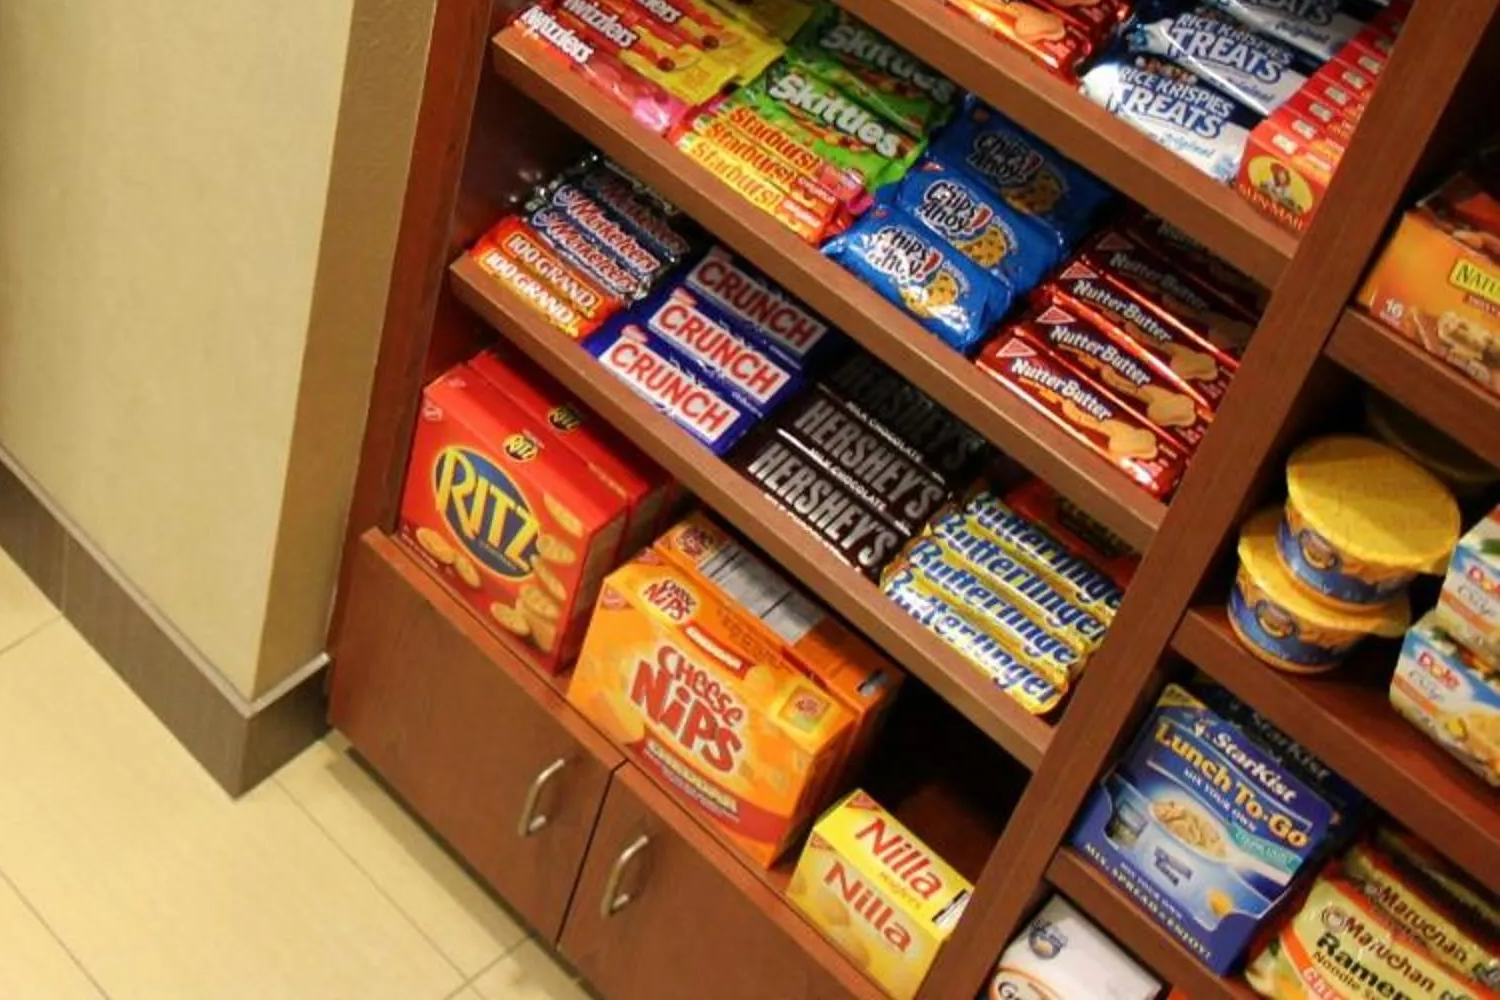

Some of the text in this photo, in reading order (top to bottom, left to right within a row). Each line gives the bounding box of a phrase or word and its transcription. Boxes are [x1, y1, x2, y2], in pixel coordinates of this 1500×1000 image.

[1168, 24, 1284, 86] TREATS
[1176, 12, 1295, 67] RICE KRISPIES
[769, 73, 900, 158] Skittles
[1112, 80, 1223, 140] TREATS
[1119, 65, 1236, 118] RICE KRISPIES
[692, 140, 784, 206] Starburst
[710, 123, 798, 188] Starburst
[730, 107, 820, 173] Starburst
[485, 252, 576, 324] 100 GRAND
[507, 235, 596, 310] 100 GRAND
[696, 260, 820, 348] CRUNCH
[609, 342, 731, 433] CRUNCH
[658, 304, 782, 395] CRUNCH
[793, 399, 945, 520] HERSHEY'S
[436, 448, 541, 574] RITZ
[747, 442, 899, 567] HERSHEY'S
[967, 494, 1127, 609] Butterfinge
[908, 538, 1082, 666] Butterfinge
[1416, 650, 1461, 692] Dole
[1154, 722, 1234, 794] Lunch
[1212, 730, 1298, 802] StarKist
[854, 816, 947, 902] Nilla
[823, 859, 913, 954] Nilla
[1377, 885, 1468, 965] Maruchan
[1312, 950, 1362, 993] Noodle
[1344, 915, 1437, 994] Maruchan
